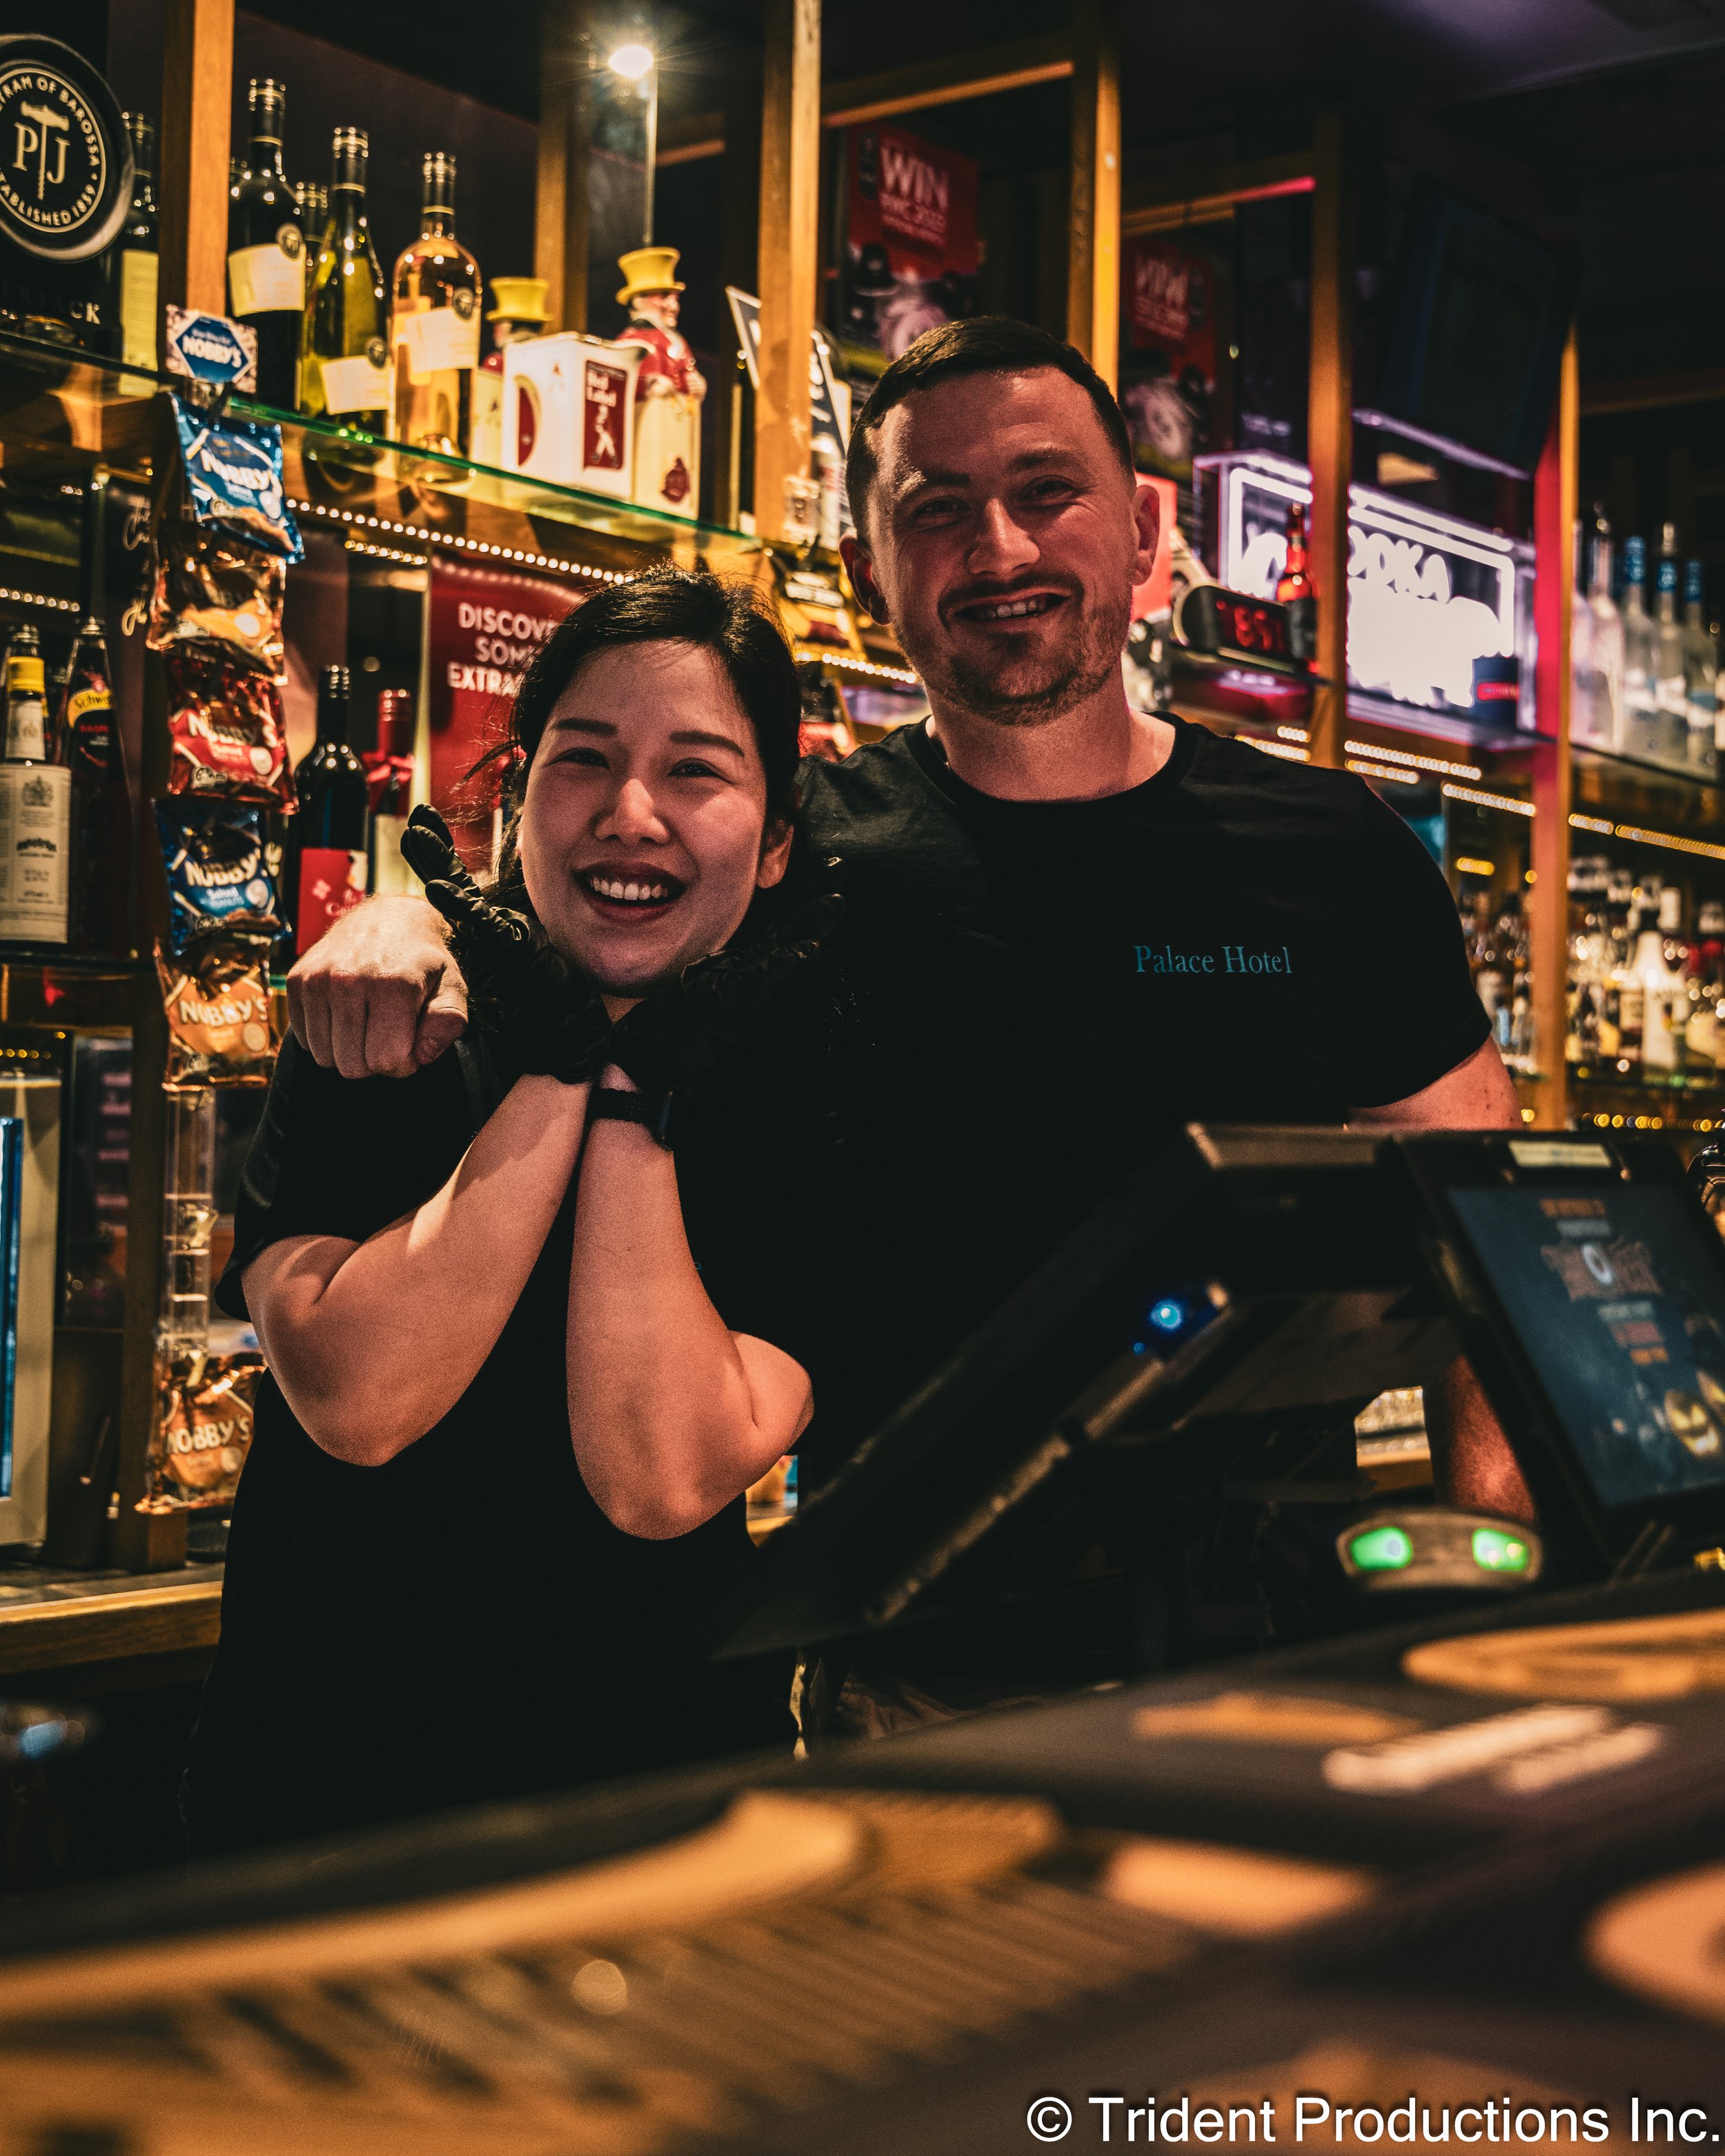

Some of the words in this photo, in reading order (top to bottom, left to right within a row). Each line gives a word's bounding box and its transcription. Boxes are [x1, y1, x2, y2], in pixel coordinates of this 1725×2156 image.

[37, 76, 57, 94] OF
[59, 88, 100, 167] BAROSSA
[880, 147, 949, 212] WIN
[182, 335, 241, 368] NOBBY'S
[1133, 945, 1215, 973] Palace
[1221, 946, 1292, 973] Hotel
